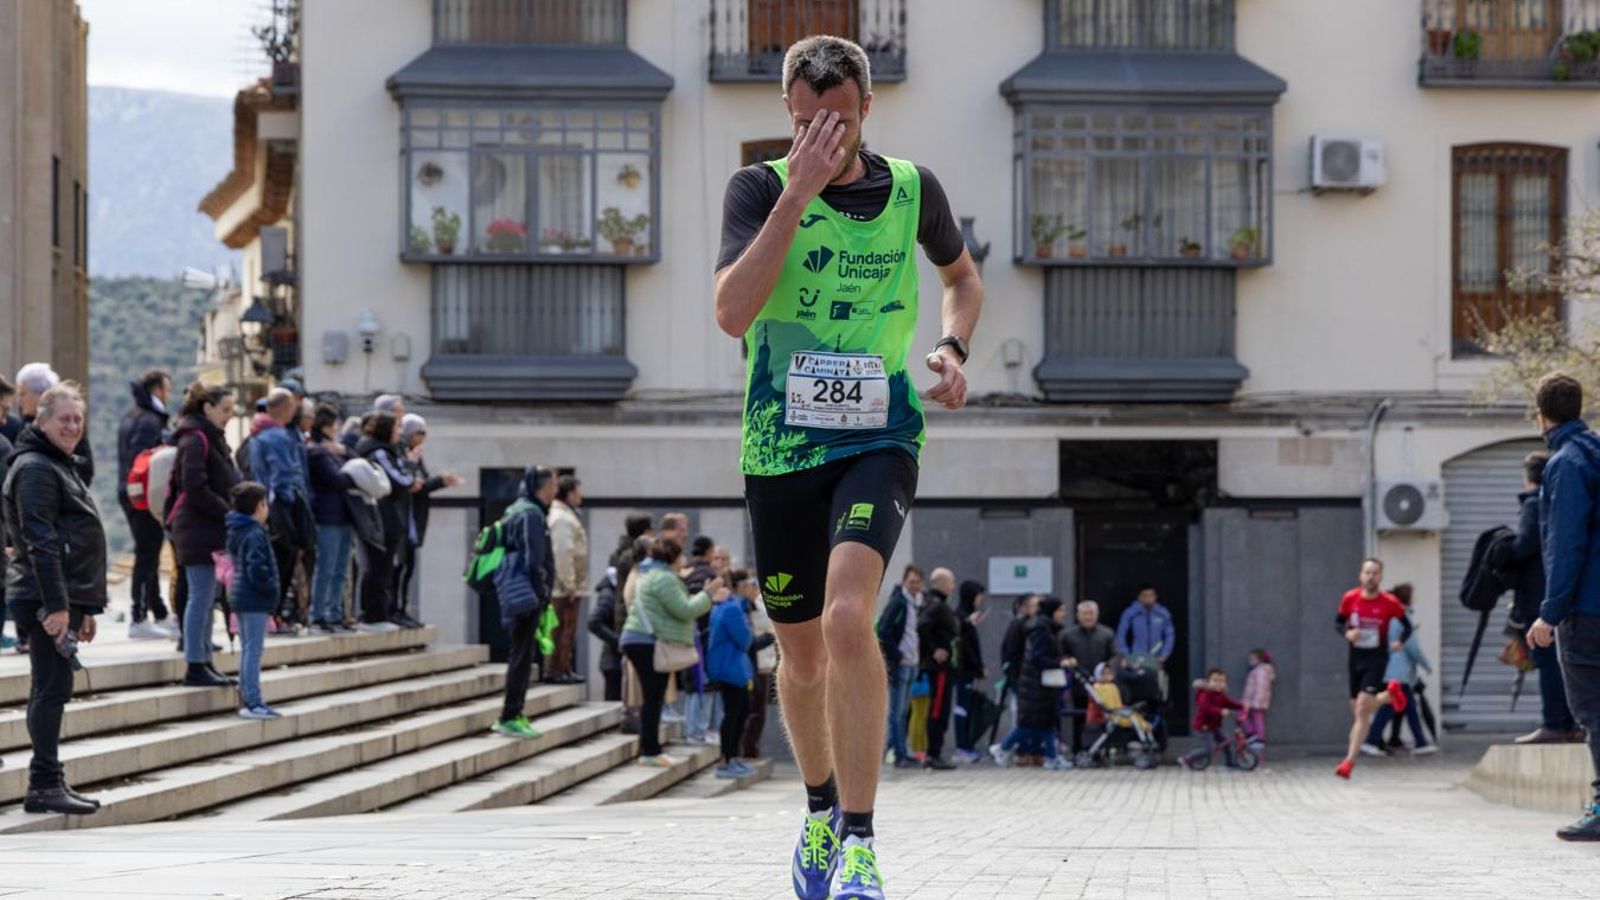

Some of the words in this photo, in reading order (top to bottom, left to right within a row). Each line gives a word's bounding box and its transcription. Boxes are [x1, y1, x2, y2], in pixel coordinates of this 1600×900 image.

[839, 249, 905, 265] Fundación
[838, 265, 891, 281] Unicaja
[836, 282, 861, 293] Jaén
[795, 355, 807, 370] V
[812, 379, 863, 403] 284
